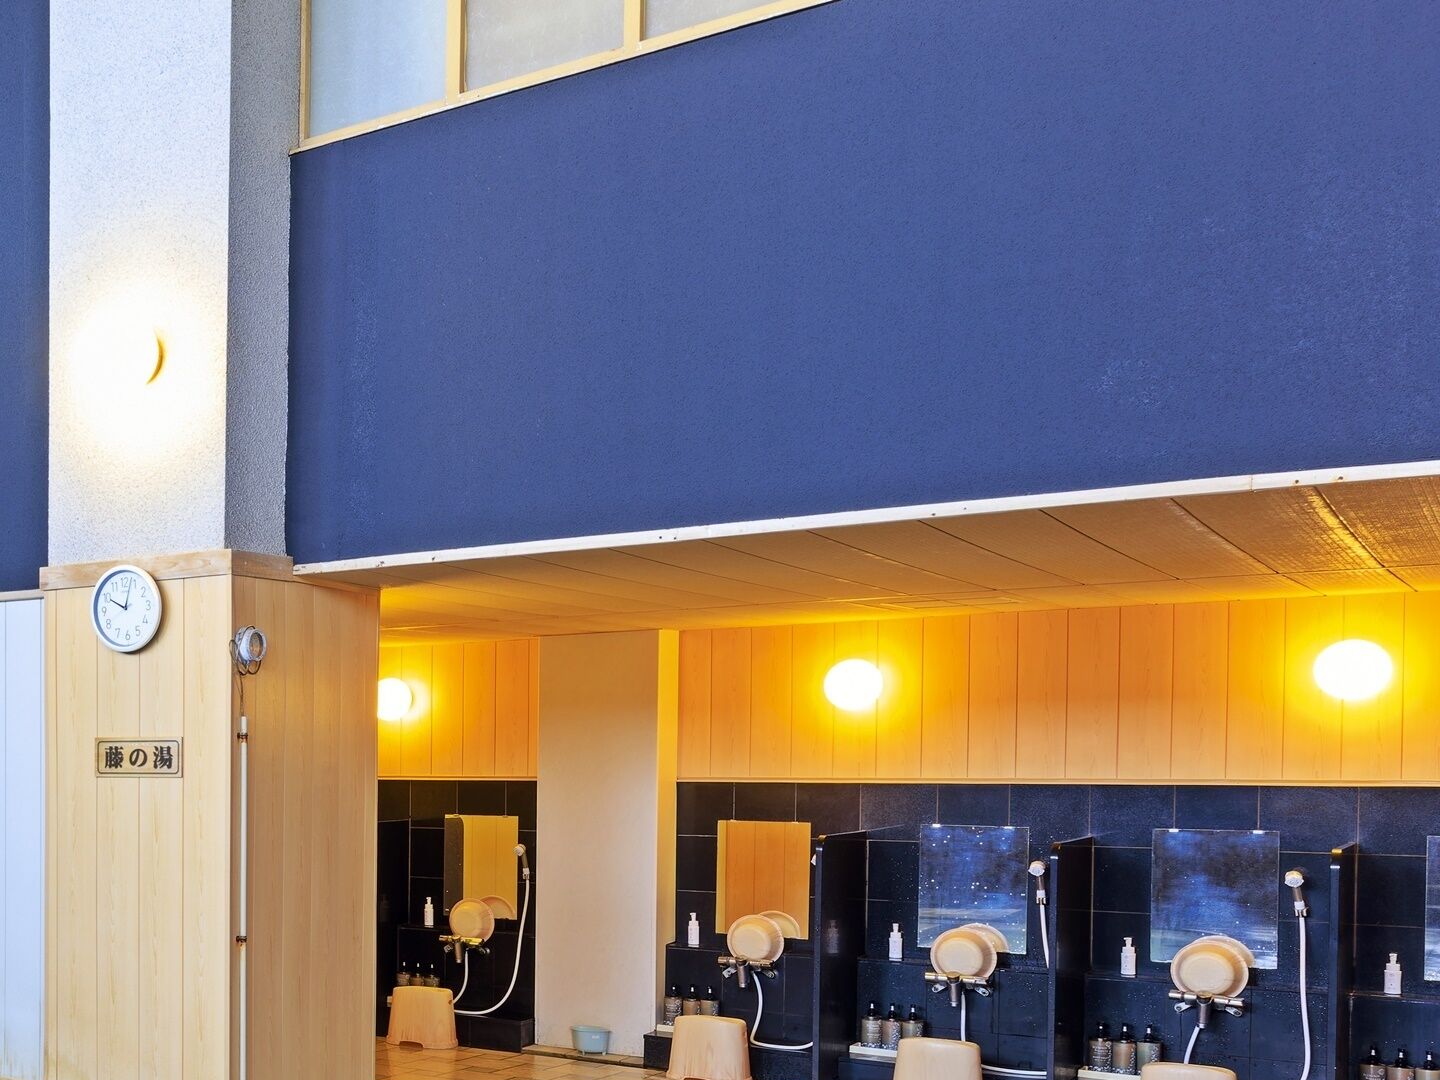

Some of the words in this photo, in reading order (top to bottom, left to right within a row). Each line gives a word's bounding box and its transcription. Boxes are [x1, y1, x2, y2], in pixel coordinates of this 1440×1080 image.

[111, 582, 118, 592] 11
[120, 576, 129, 588] 12
[133, 579, 137, 589] 1
[103, 592, 111, 603] 10
[141, 586, 146, 598] 2
[101, 606, 107, 616] 9
[145, 600, 151, 611] 3
[105, 618, 112, 629] 8
[142, 614, 148, 624] 4
[115, 627, 120, 638] 7
[125, 630, 131, 640] 6
[135, 625, 141, 636] 5
[104, 745, 173, 769] 藤の湯
